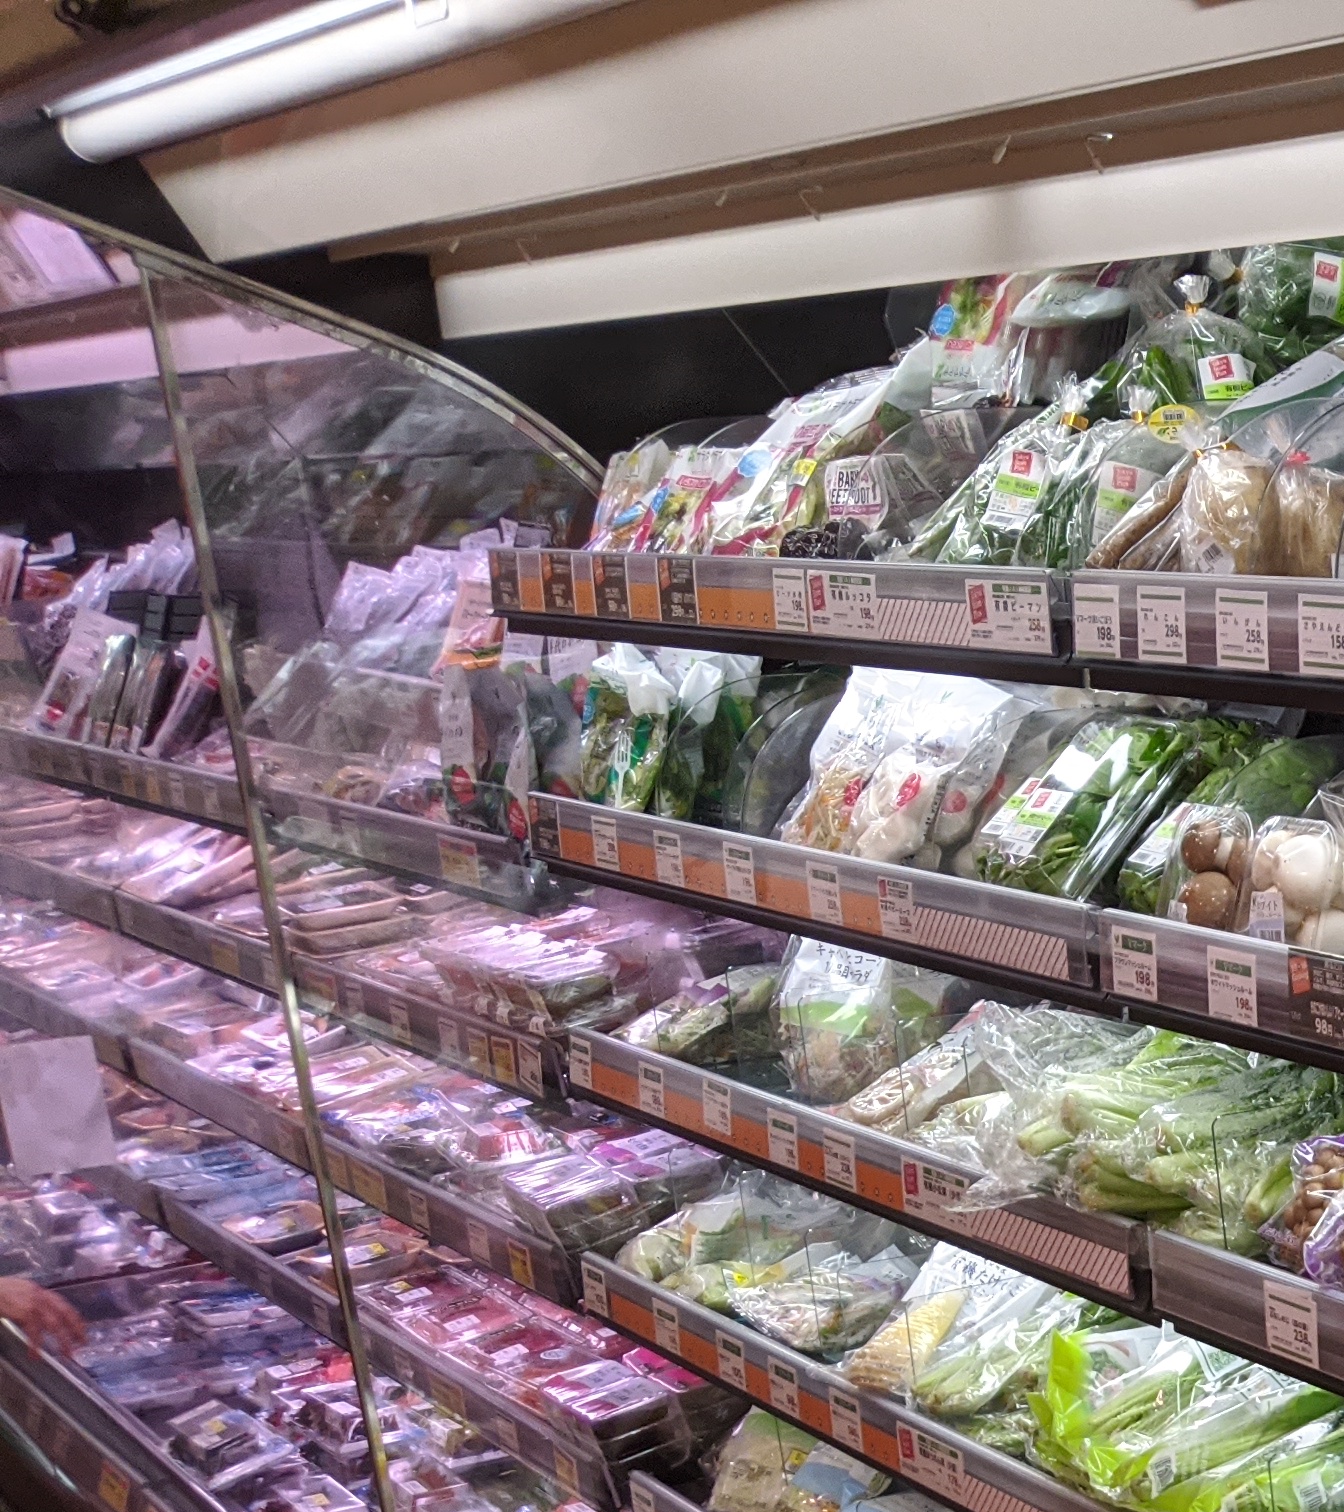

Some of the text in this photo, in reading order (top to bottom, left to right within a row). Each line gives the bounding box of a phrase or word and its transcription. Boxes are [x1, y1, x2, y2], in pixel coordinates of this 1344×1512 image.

[1096, 626, 1115, 641] 198円
[1165, 623, 1183, 639] 298円
[1245, 628, 1265, 645] 258円
